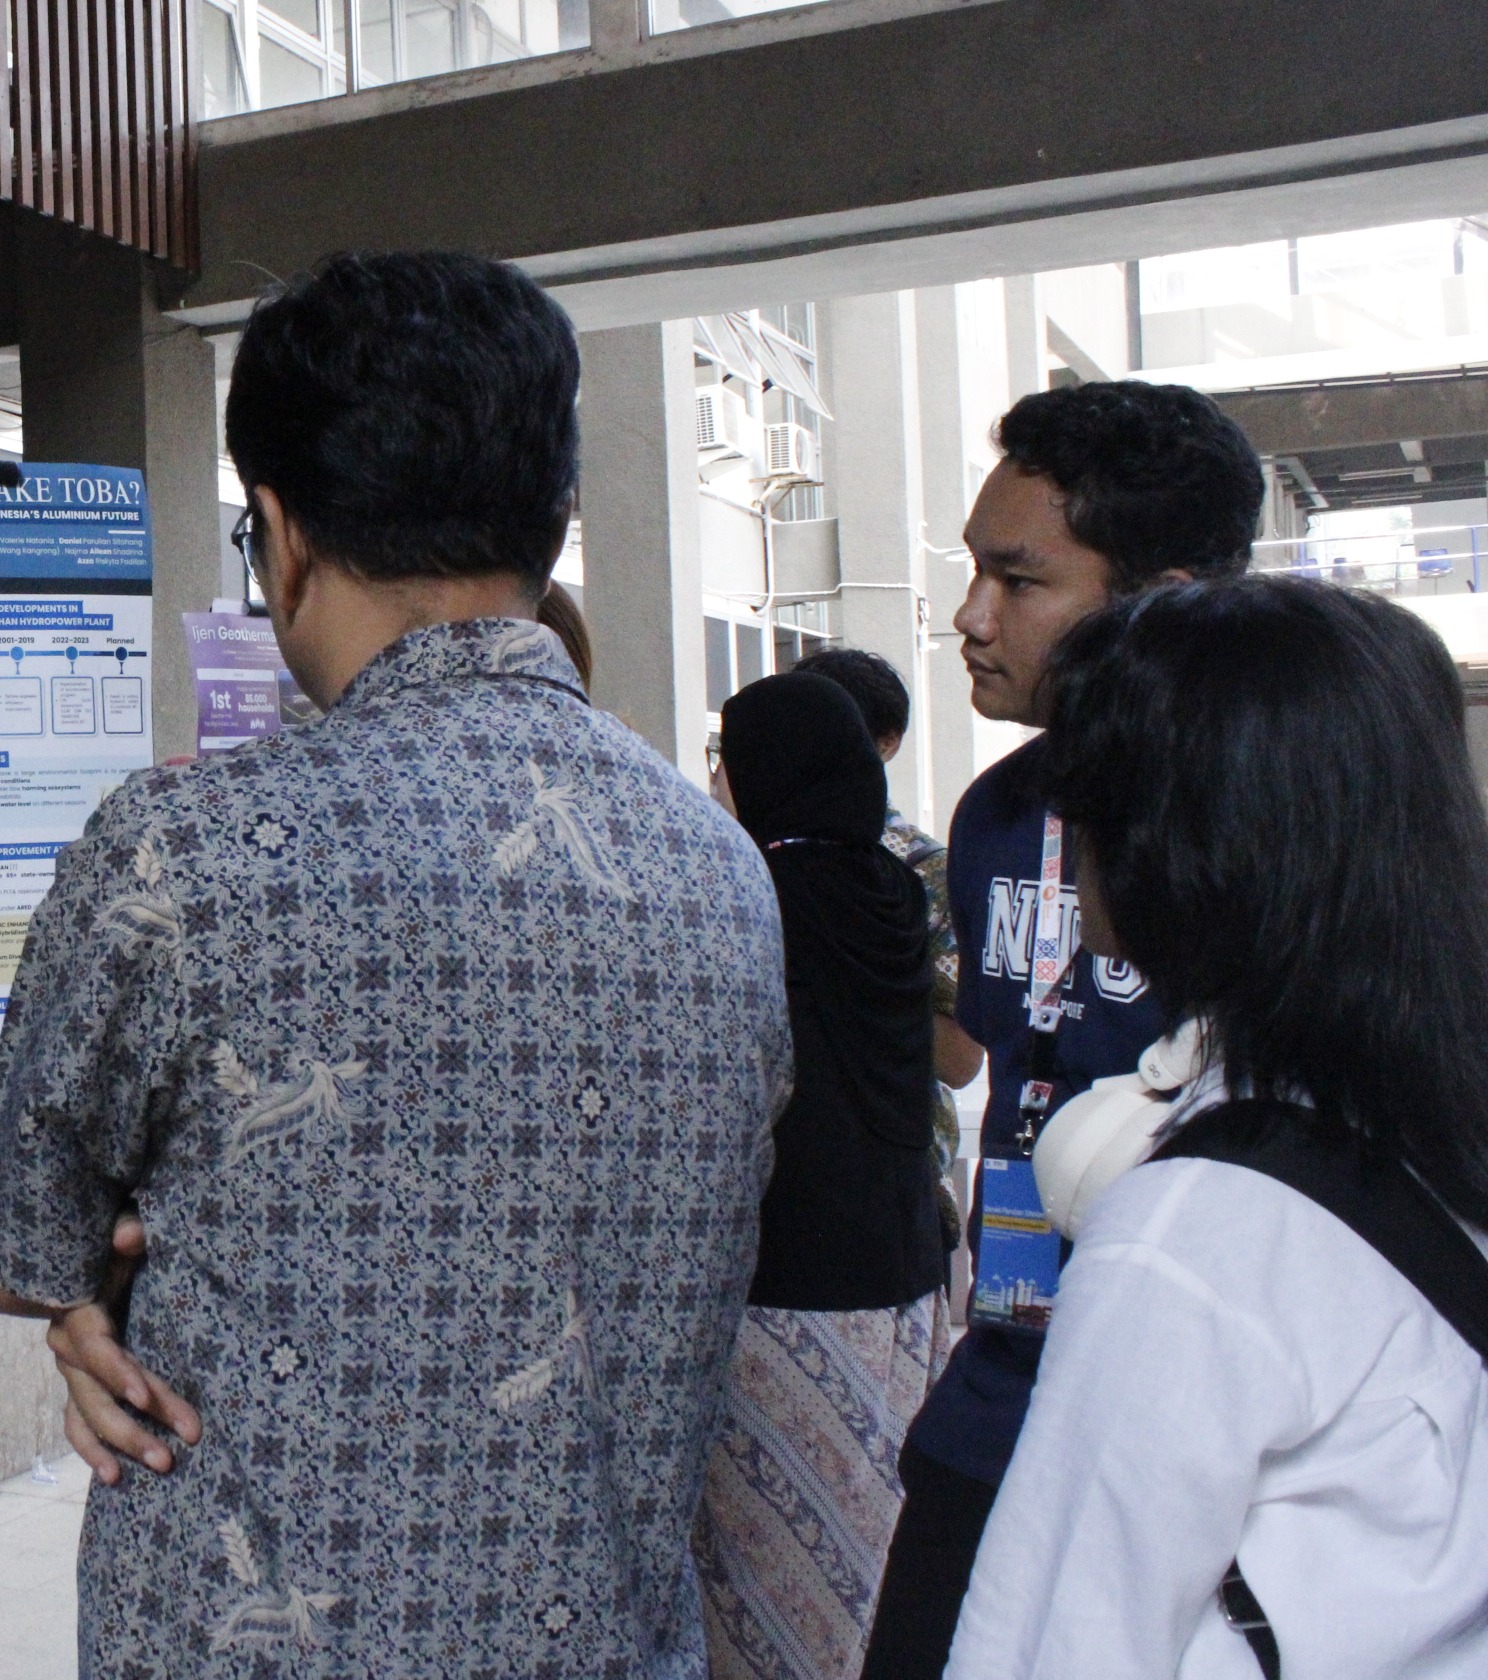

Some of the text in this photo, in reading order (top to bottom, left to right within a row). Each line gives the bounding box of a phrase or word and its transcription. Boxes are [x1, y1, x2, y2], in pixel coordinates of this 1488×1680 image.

[58, 478, 141, 504] TOBA?
[42, 510, 100, 520] ALUMINIUM
[102, 511, 140, 521] FUTURE
[59, 537, 82, 545] Daniel
[69, 605, 78, 613] IN
[20, 618, 82, 626] HYDROPOWER
[84, 618, 110, 626] PLANT
[192, 625, 276, 643] Ijen Geotherma
[210, 690, 231, 710] 1st
[238, 703, 275, 713] households
